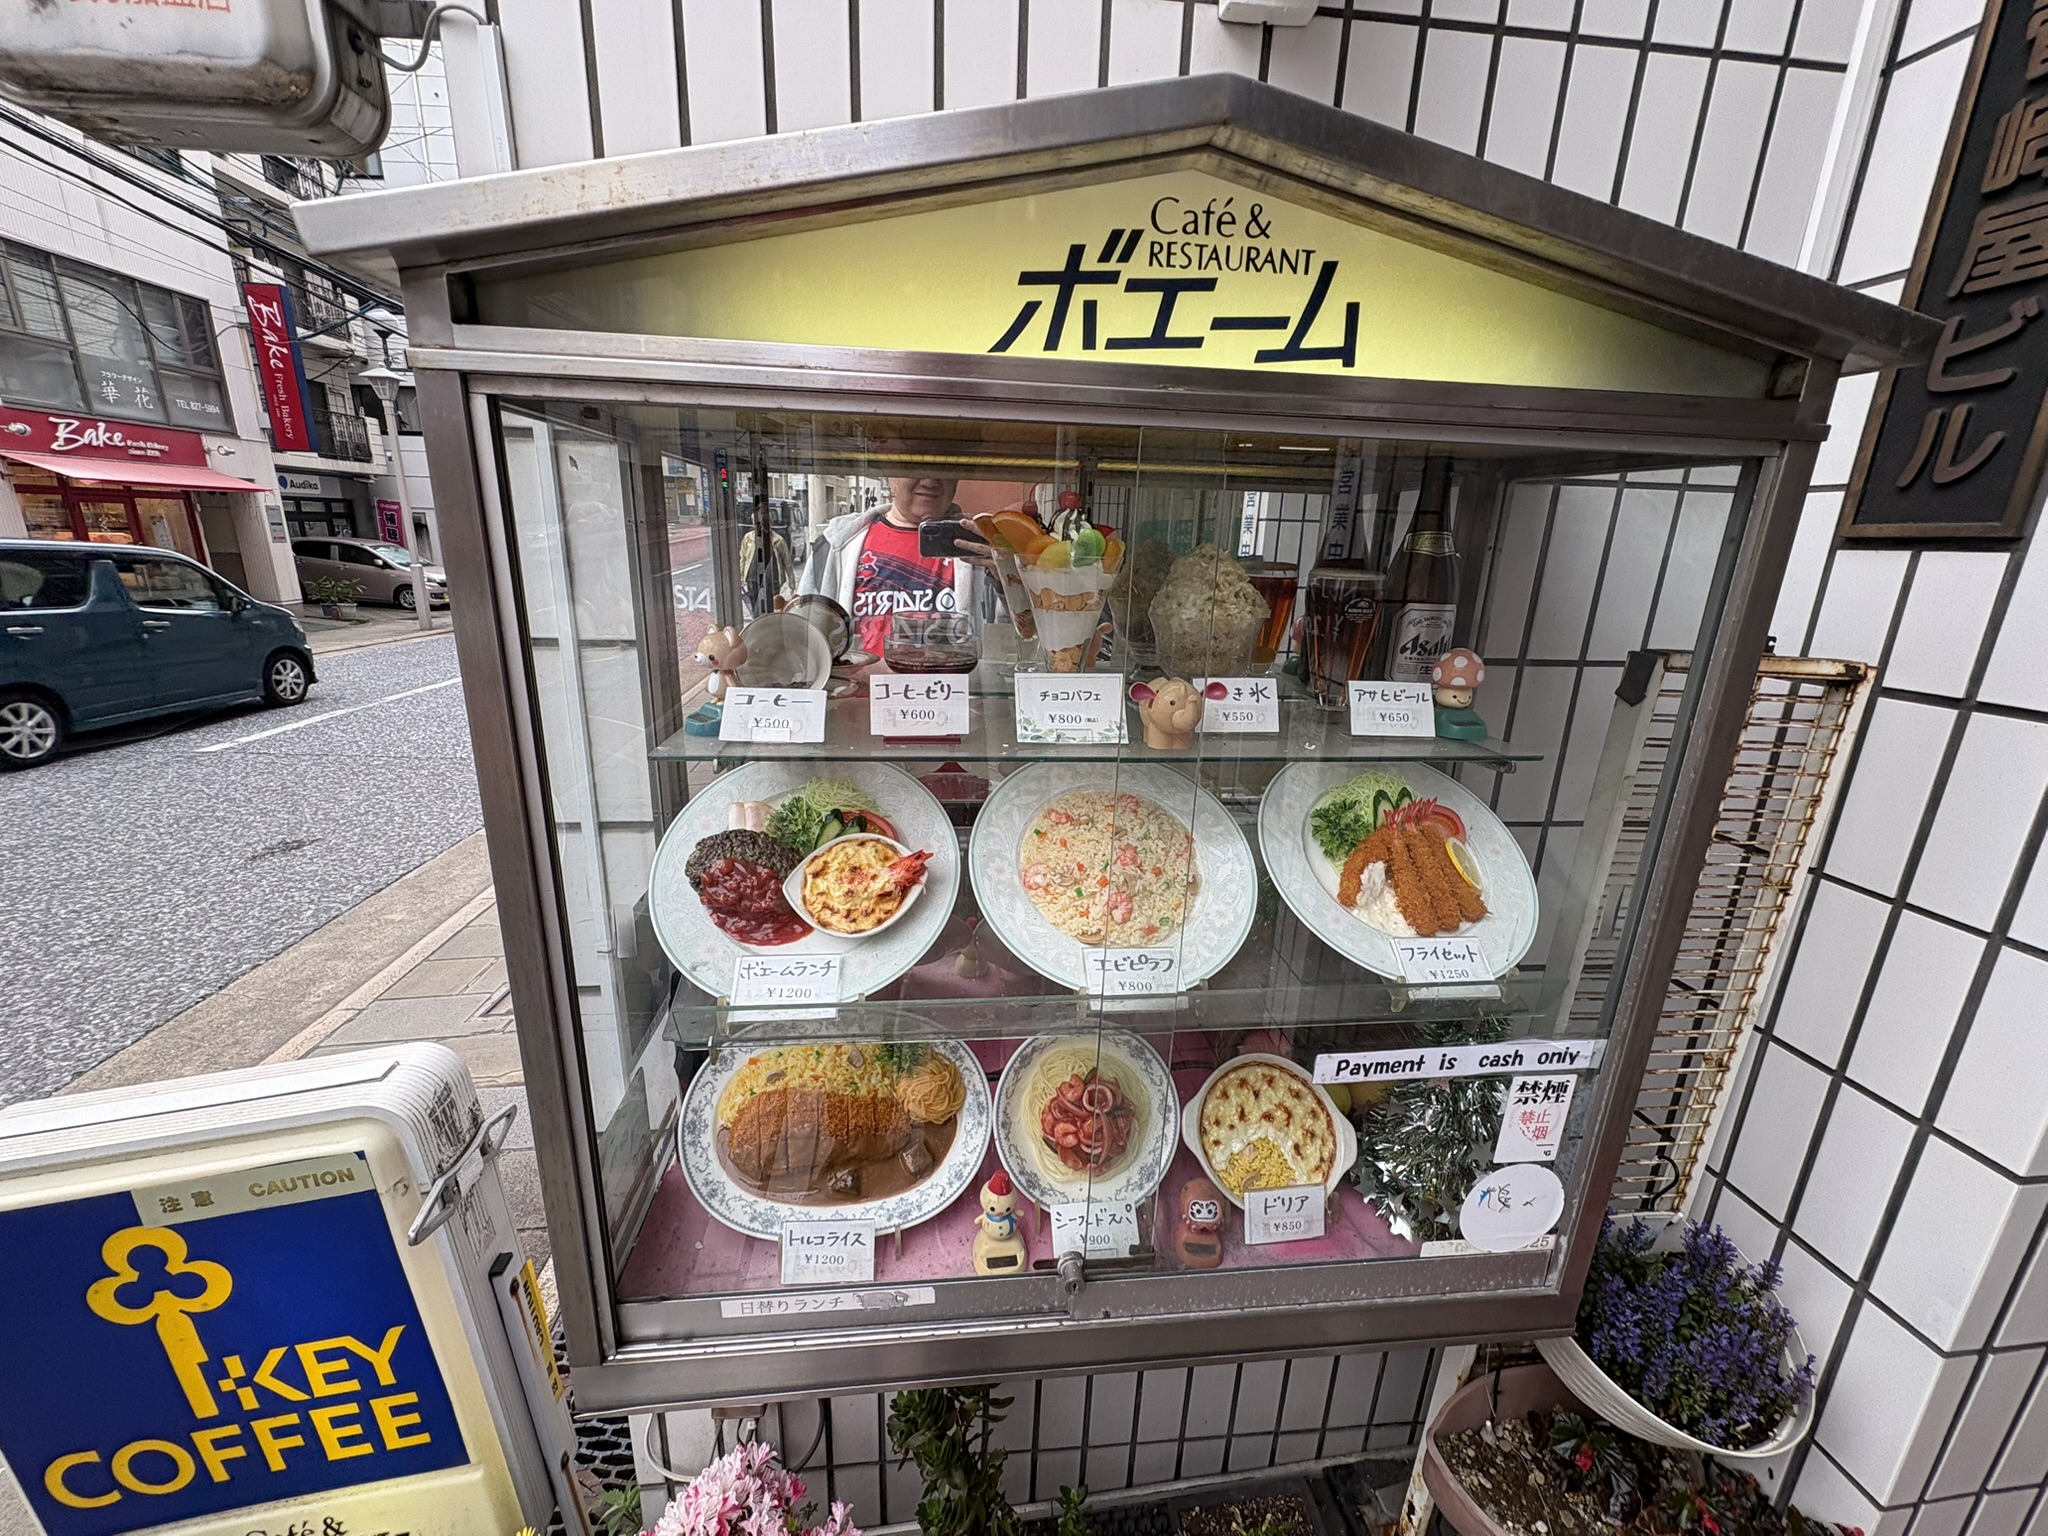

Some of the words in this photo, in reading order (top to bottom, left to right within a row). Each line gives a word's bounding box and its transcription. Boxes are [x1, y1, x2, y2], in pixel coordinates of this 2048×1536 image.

[1151, 197, 1237, 238] Café
[1245, 203, 1272, 239] &
[1149, 241, 1316, 275] RESTAURANT
[987, 229, 1361, 368] ボエーム
[247, 295, 289, 370] Bake
[274, 372, 288, 401] Fresh
[175, 399, 190, 410] TEL
[280, 404, 294, 440] Bakery
[48, 416, 126, 451] Bake
[290, 480, 319, 490] Audika
[875, 680, 966, 701] コーヒーゼリー
[1039, 690, 1102, 701] チョコパフェ
[1232, 682, 1271, 703] き氷
[1354, 689, 1430, 704] アサヒビール
[734, 694, 813, 707] コーヒー
[754, 717, 789, 728] ¥500
[900, 709, 935, 720] ¥600
[1048, 713, 1082, 724] ¥800
[1222, 712, 1253, 721] ¥550
[1380, 713, 1409, 722] ¥650
[740, 960, 837, 980] ボエームランチ
[1093, 954, 1174, 972] エビピラフ
[1429, 969, 1469, 979] ¥1250
[766, 987, 812, 998] ¥1200
[1118, 980, 1152, 991] ¥800
[1335, 1055, 1425, 1078] Payment
[1439, 1053, 1458, 1071] is
[1478, 1050, 1524, 1068] cash
[1512, 1080, 1570, 1105] 禁煙
[1519, 1109, 1551, 1125] 禁止
[248, 1167, 355, 1197] CAUTION
[1264, 1196, 1309, 1215] ドリア
[1274, 1221, 1302, 1231] ¥850
[789, 1229, 867, 1247] トルコライス
[1080, 1234, 1110, 1245] ¥900
[805, 1254, 844, 1265] ¥1200
[740, 1296, 844, 1315] 日替りランチ
[218, 1324, 407, 1411] KEY
[43, 1391, 432, 1509] COFFEE
